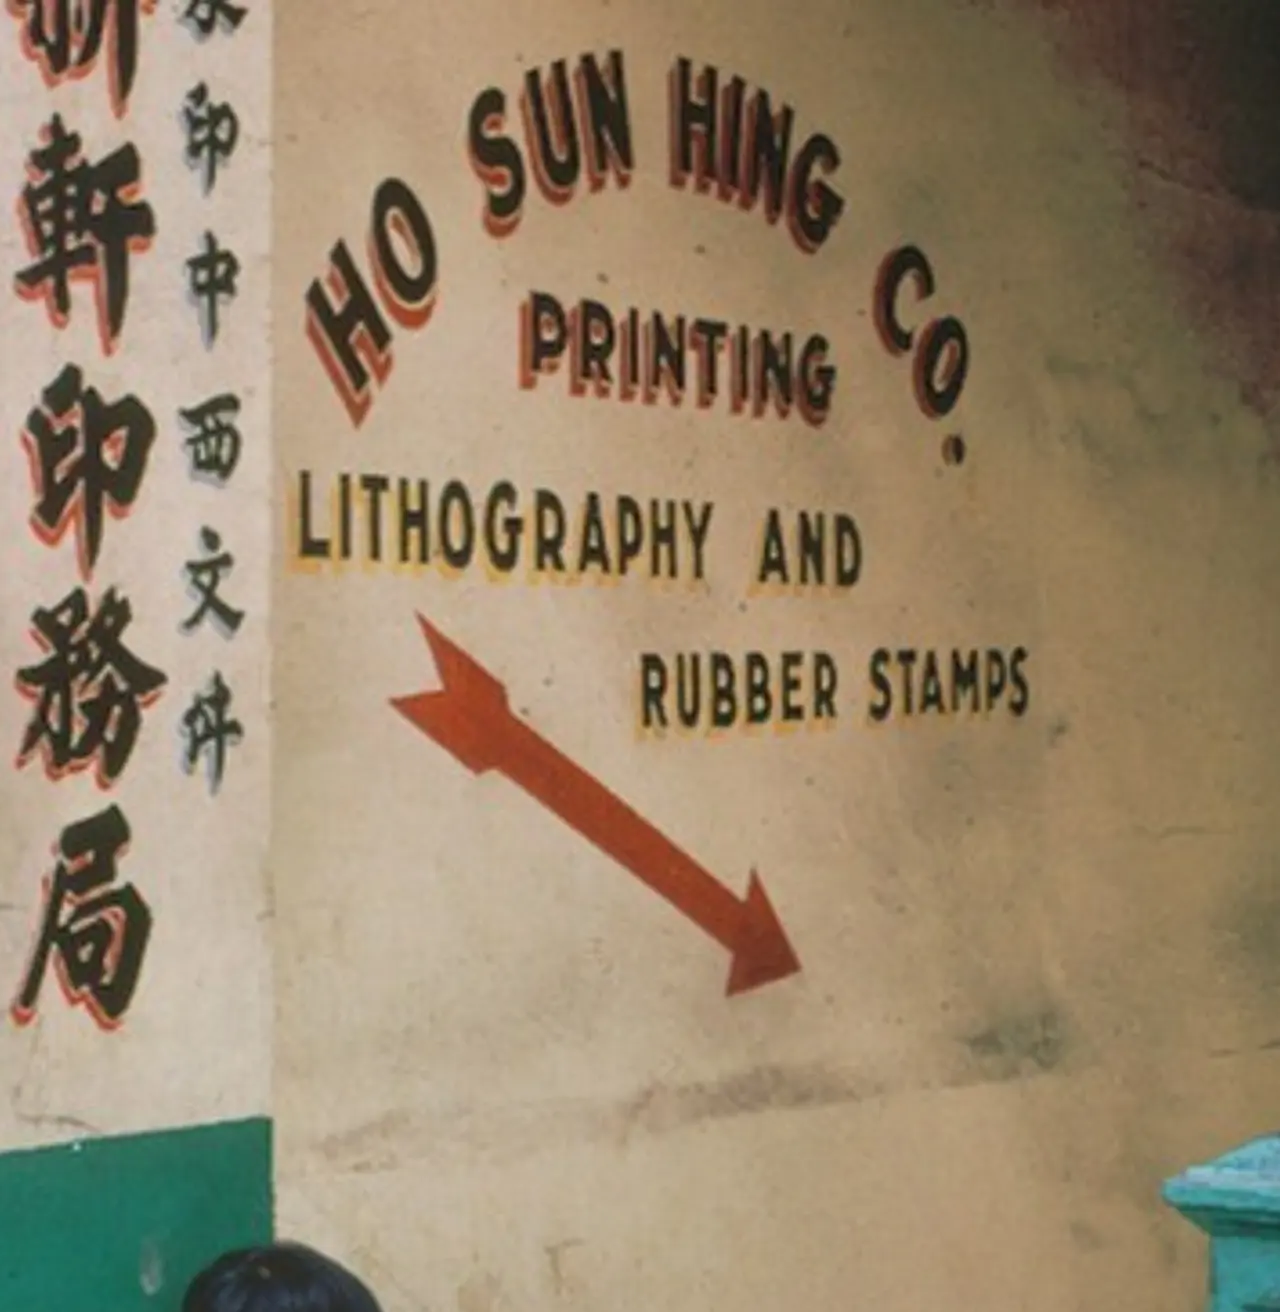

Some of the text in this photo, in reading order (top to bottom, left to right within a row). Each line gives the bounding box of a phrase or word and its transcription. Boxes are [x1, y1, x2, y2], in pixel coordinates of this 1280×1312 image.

[306, 176, 439, 428] HO
[466, 49, 634, 238] SUN
[667, 56, 845, 255] HING
[520, 290, 836, 428] PRINTING
[290, 469, 864, 591] LITHOGRAPHY AND
[638, 645, 1031, 732] RUBBER STAMPS
